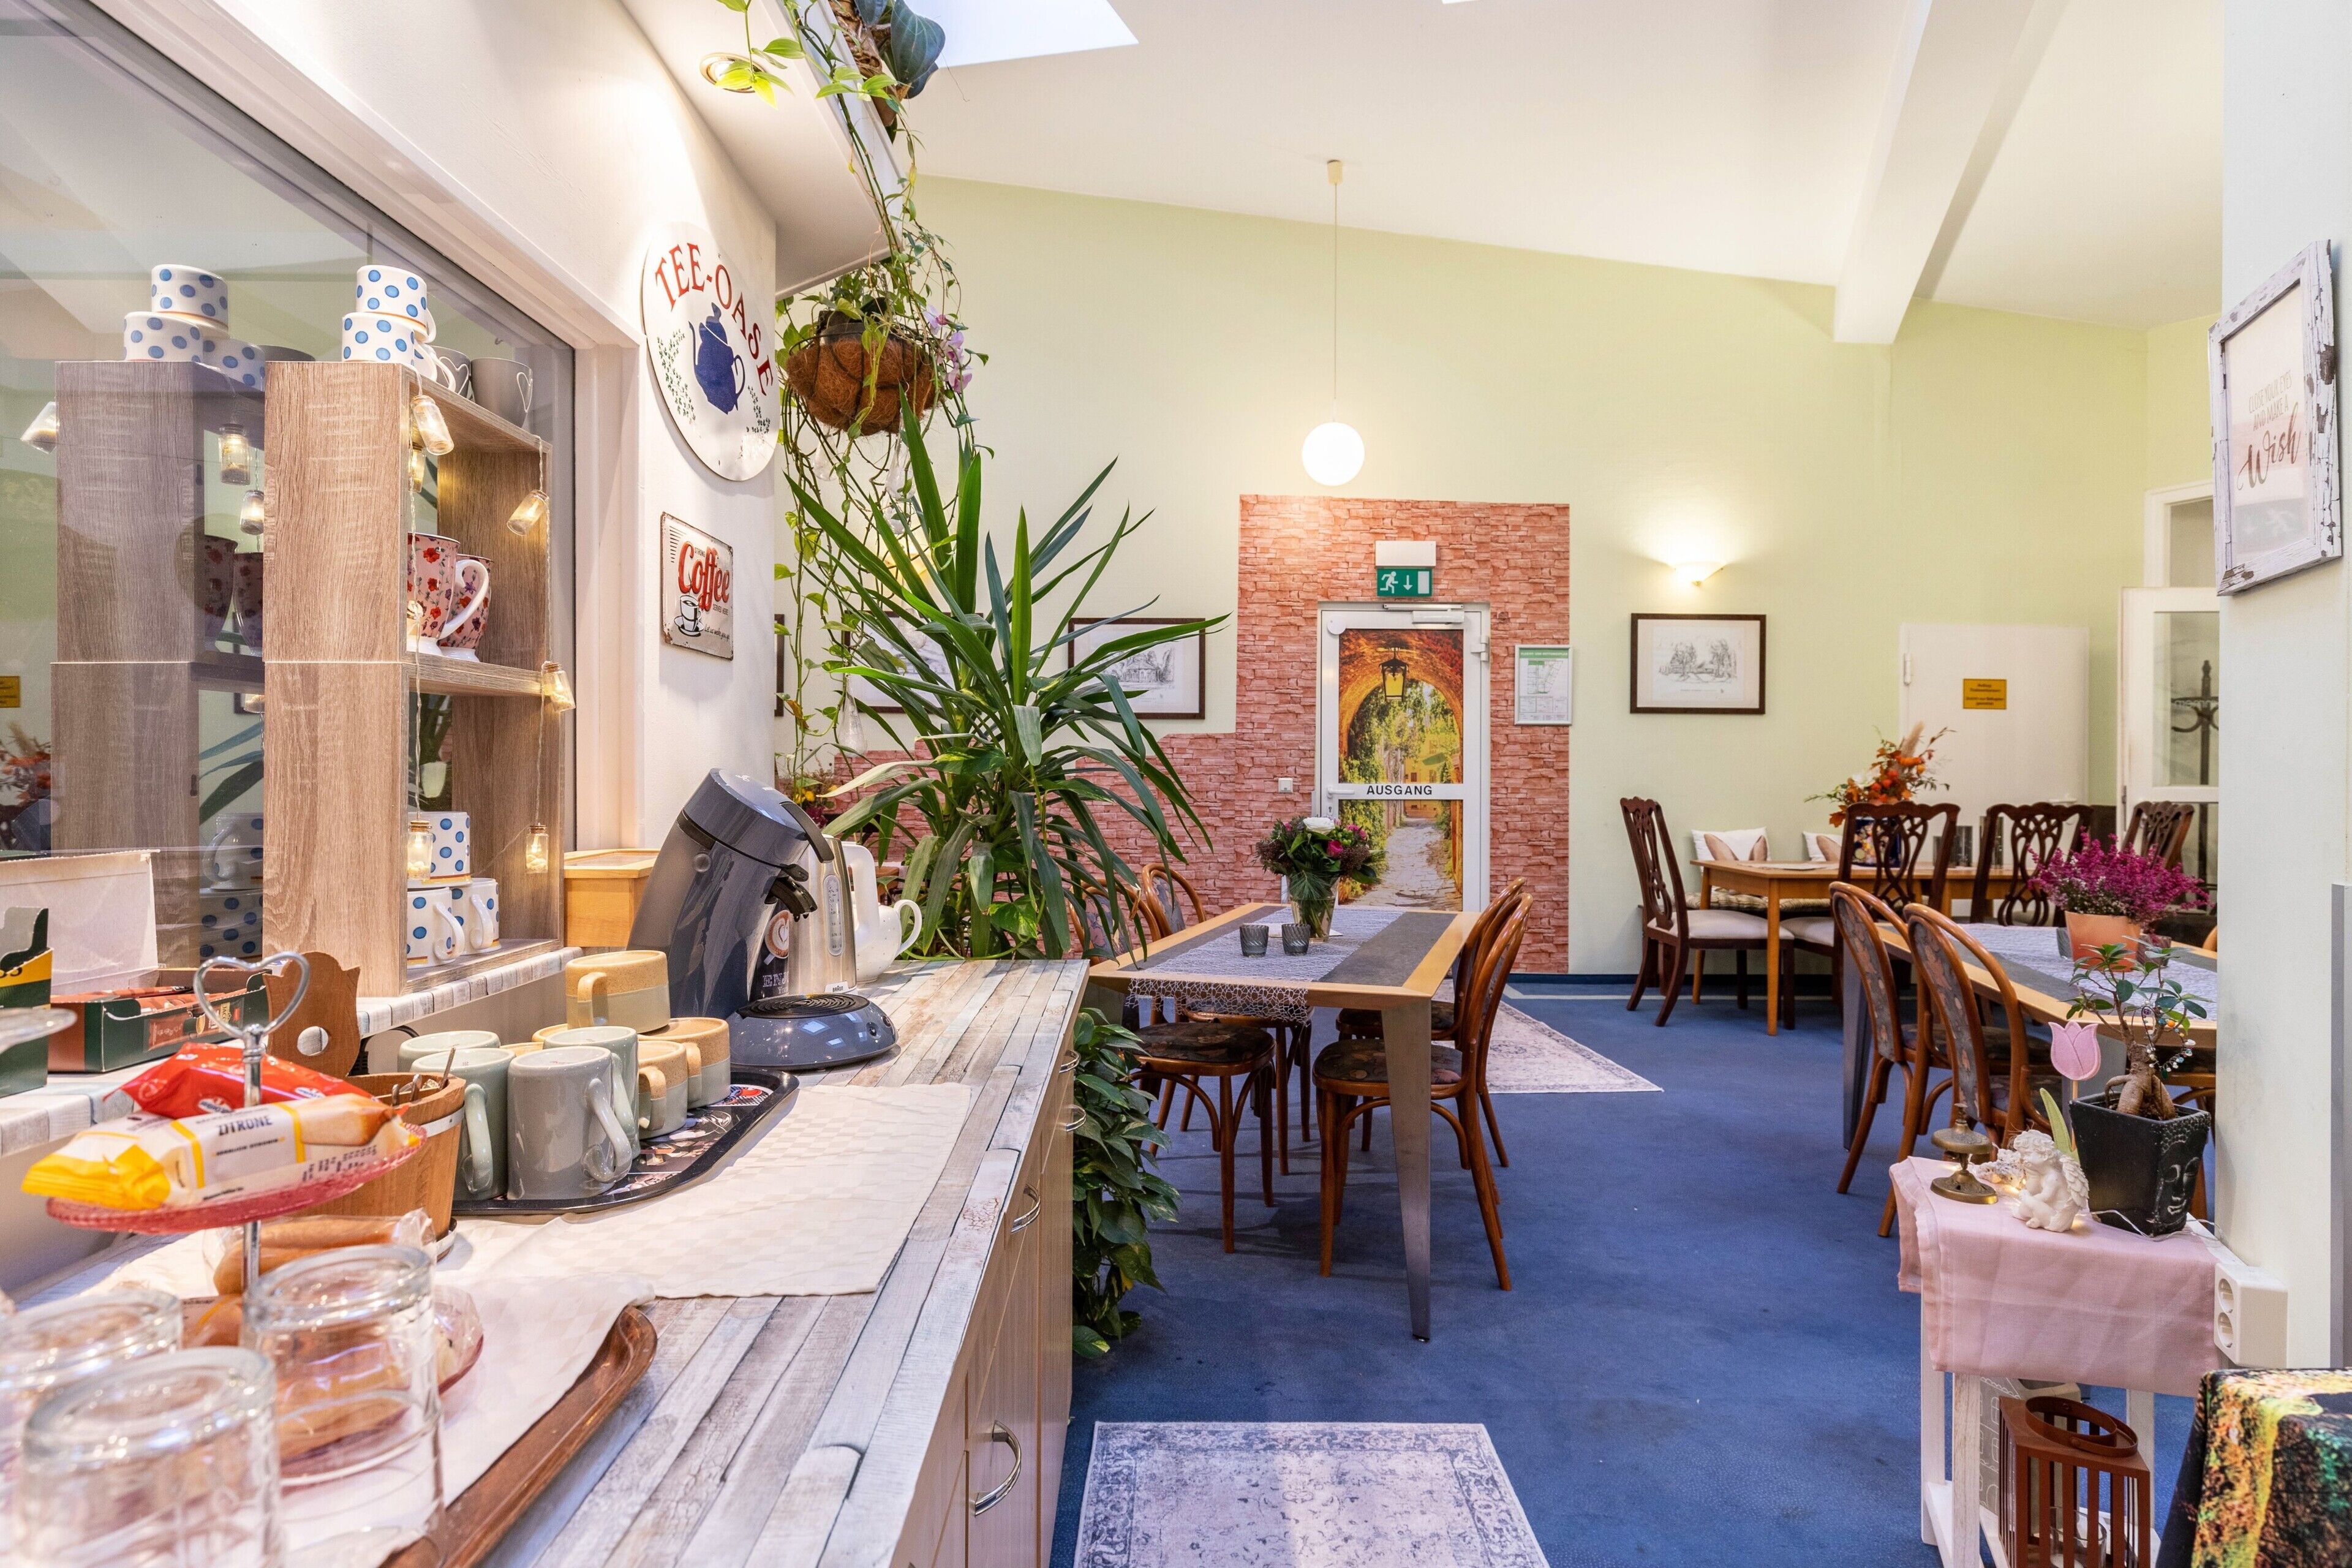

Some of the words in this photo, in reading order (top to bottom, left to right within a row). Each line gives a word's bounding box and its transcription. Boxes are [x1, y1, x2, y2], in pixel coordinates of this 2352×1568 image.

[2248, 388, 2264, 413] CLOSE
[2264, 378, 2279, 402] YOUR
[2280, 369, 2291, 393] EYES
[2253, 409, 2266, 431] AND
[2267, 397, 2283, 424] MAKE
[2285, 393, 2289, 412] A
[2237, 402, 2301, 490] Wish
[678, 541, 729, 611] Coffee
[1366, 785, 1432, 795] AUSGANG
[218, 1115, 273, 1136] ZITRONE
